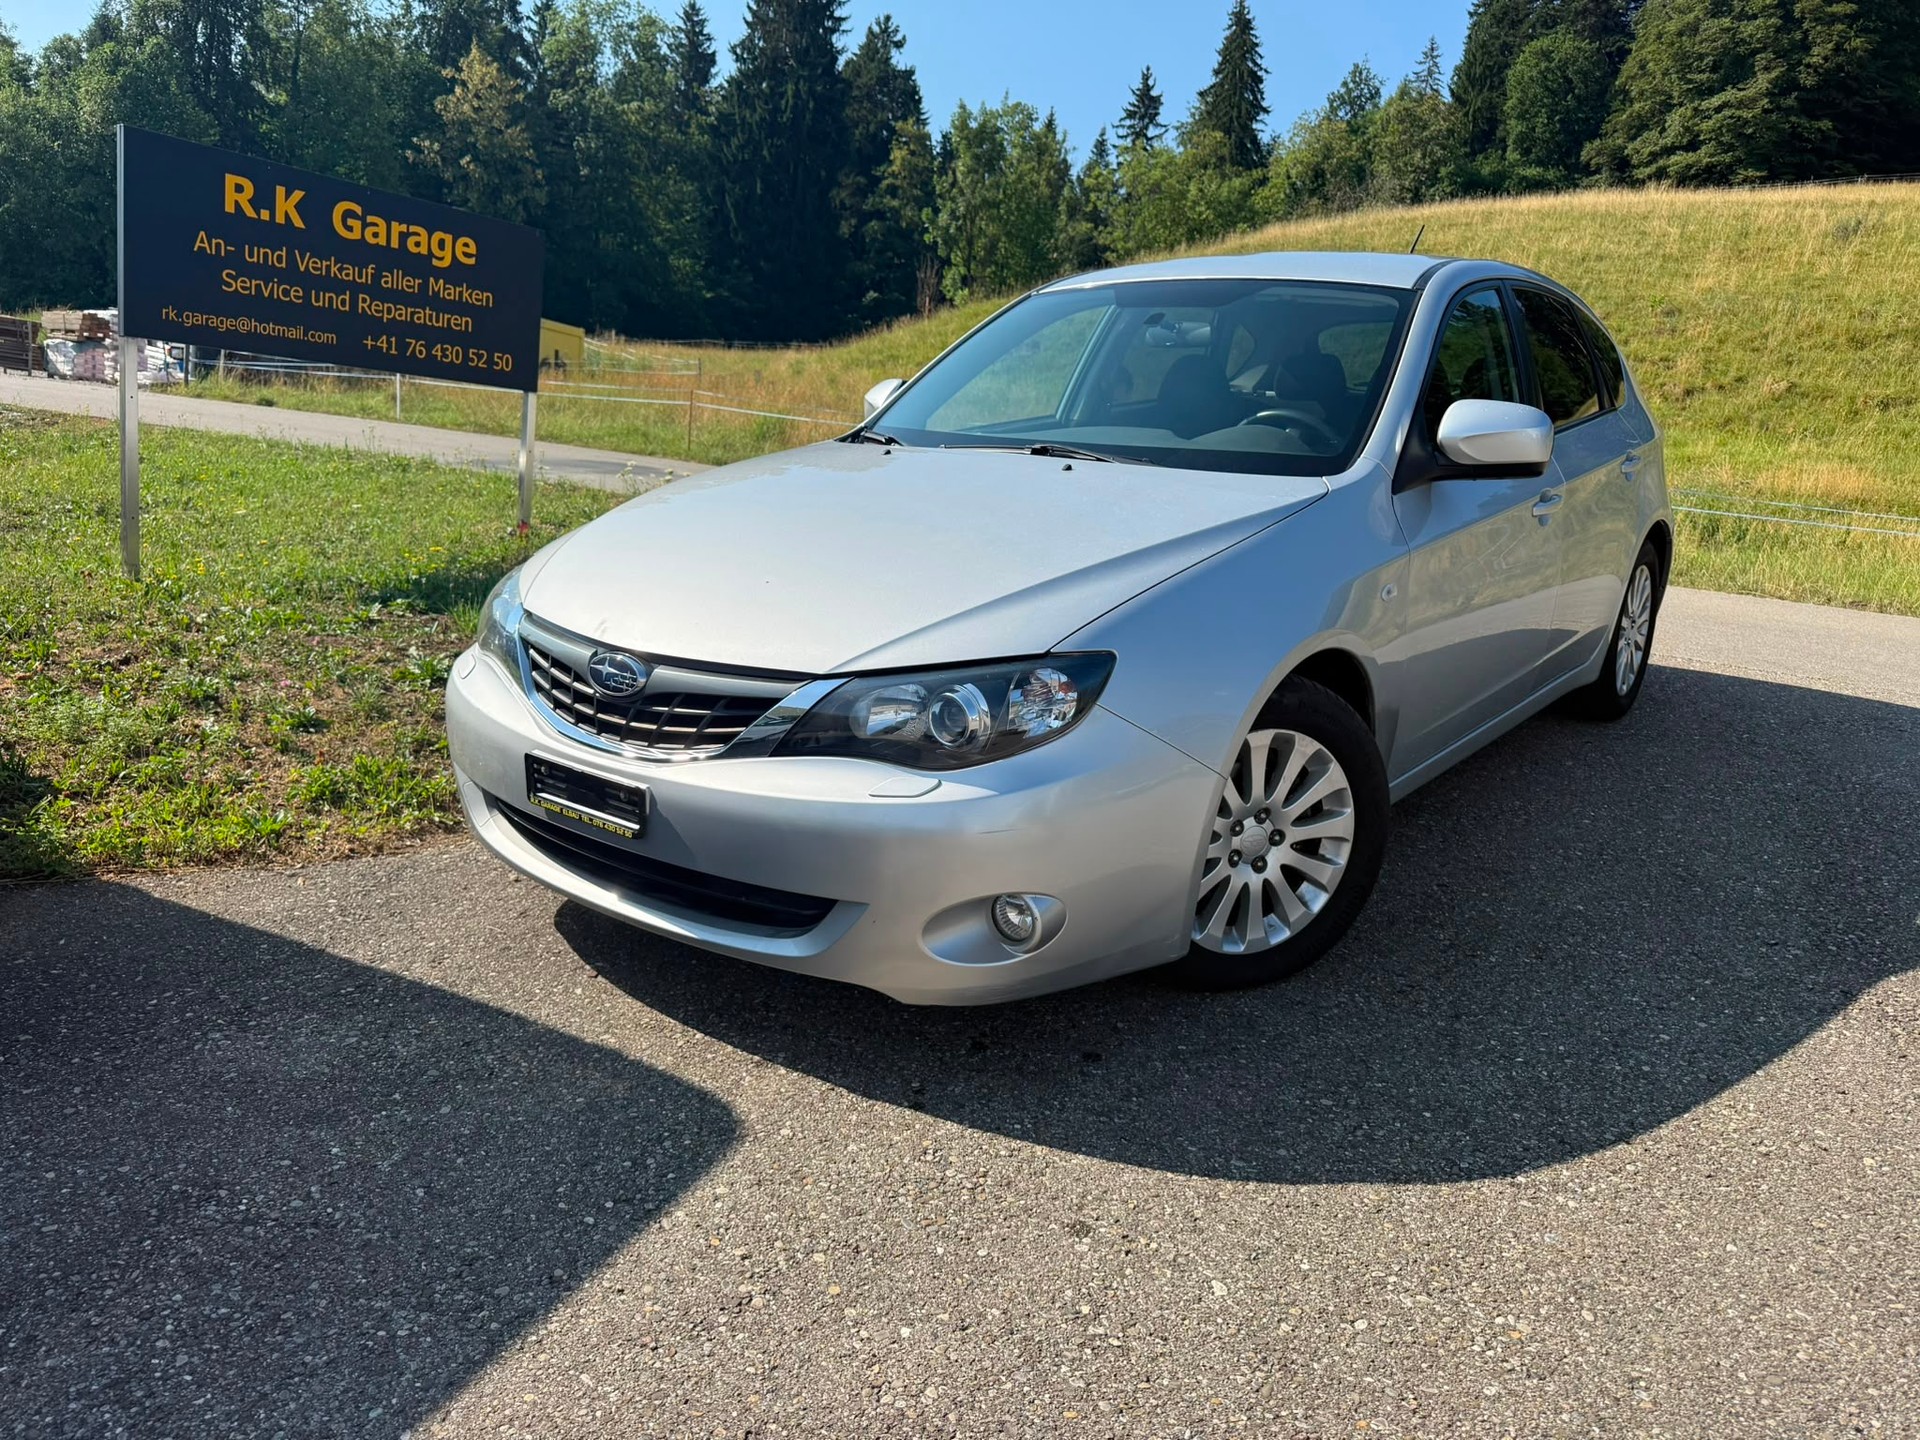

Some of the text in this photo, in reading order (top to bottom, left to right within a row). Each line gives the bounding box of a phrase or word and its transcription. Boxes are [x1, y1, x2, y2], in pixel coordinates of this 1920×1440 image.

[224, 173, 477, 267] R.K Garage
[193, 230, 494, 307] An- und Verkauf aller Marken
[161, 305, 337, 345] rk.garage@hotmail.com
[221, 269, 473, 333] Service und Reparaturen
[363, 336, 513, 372] +41 76 430 52 50
